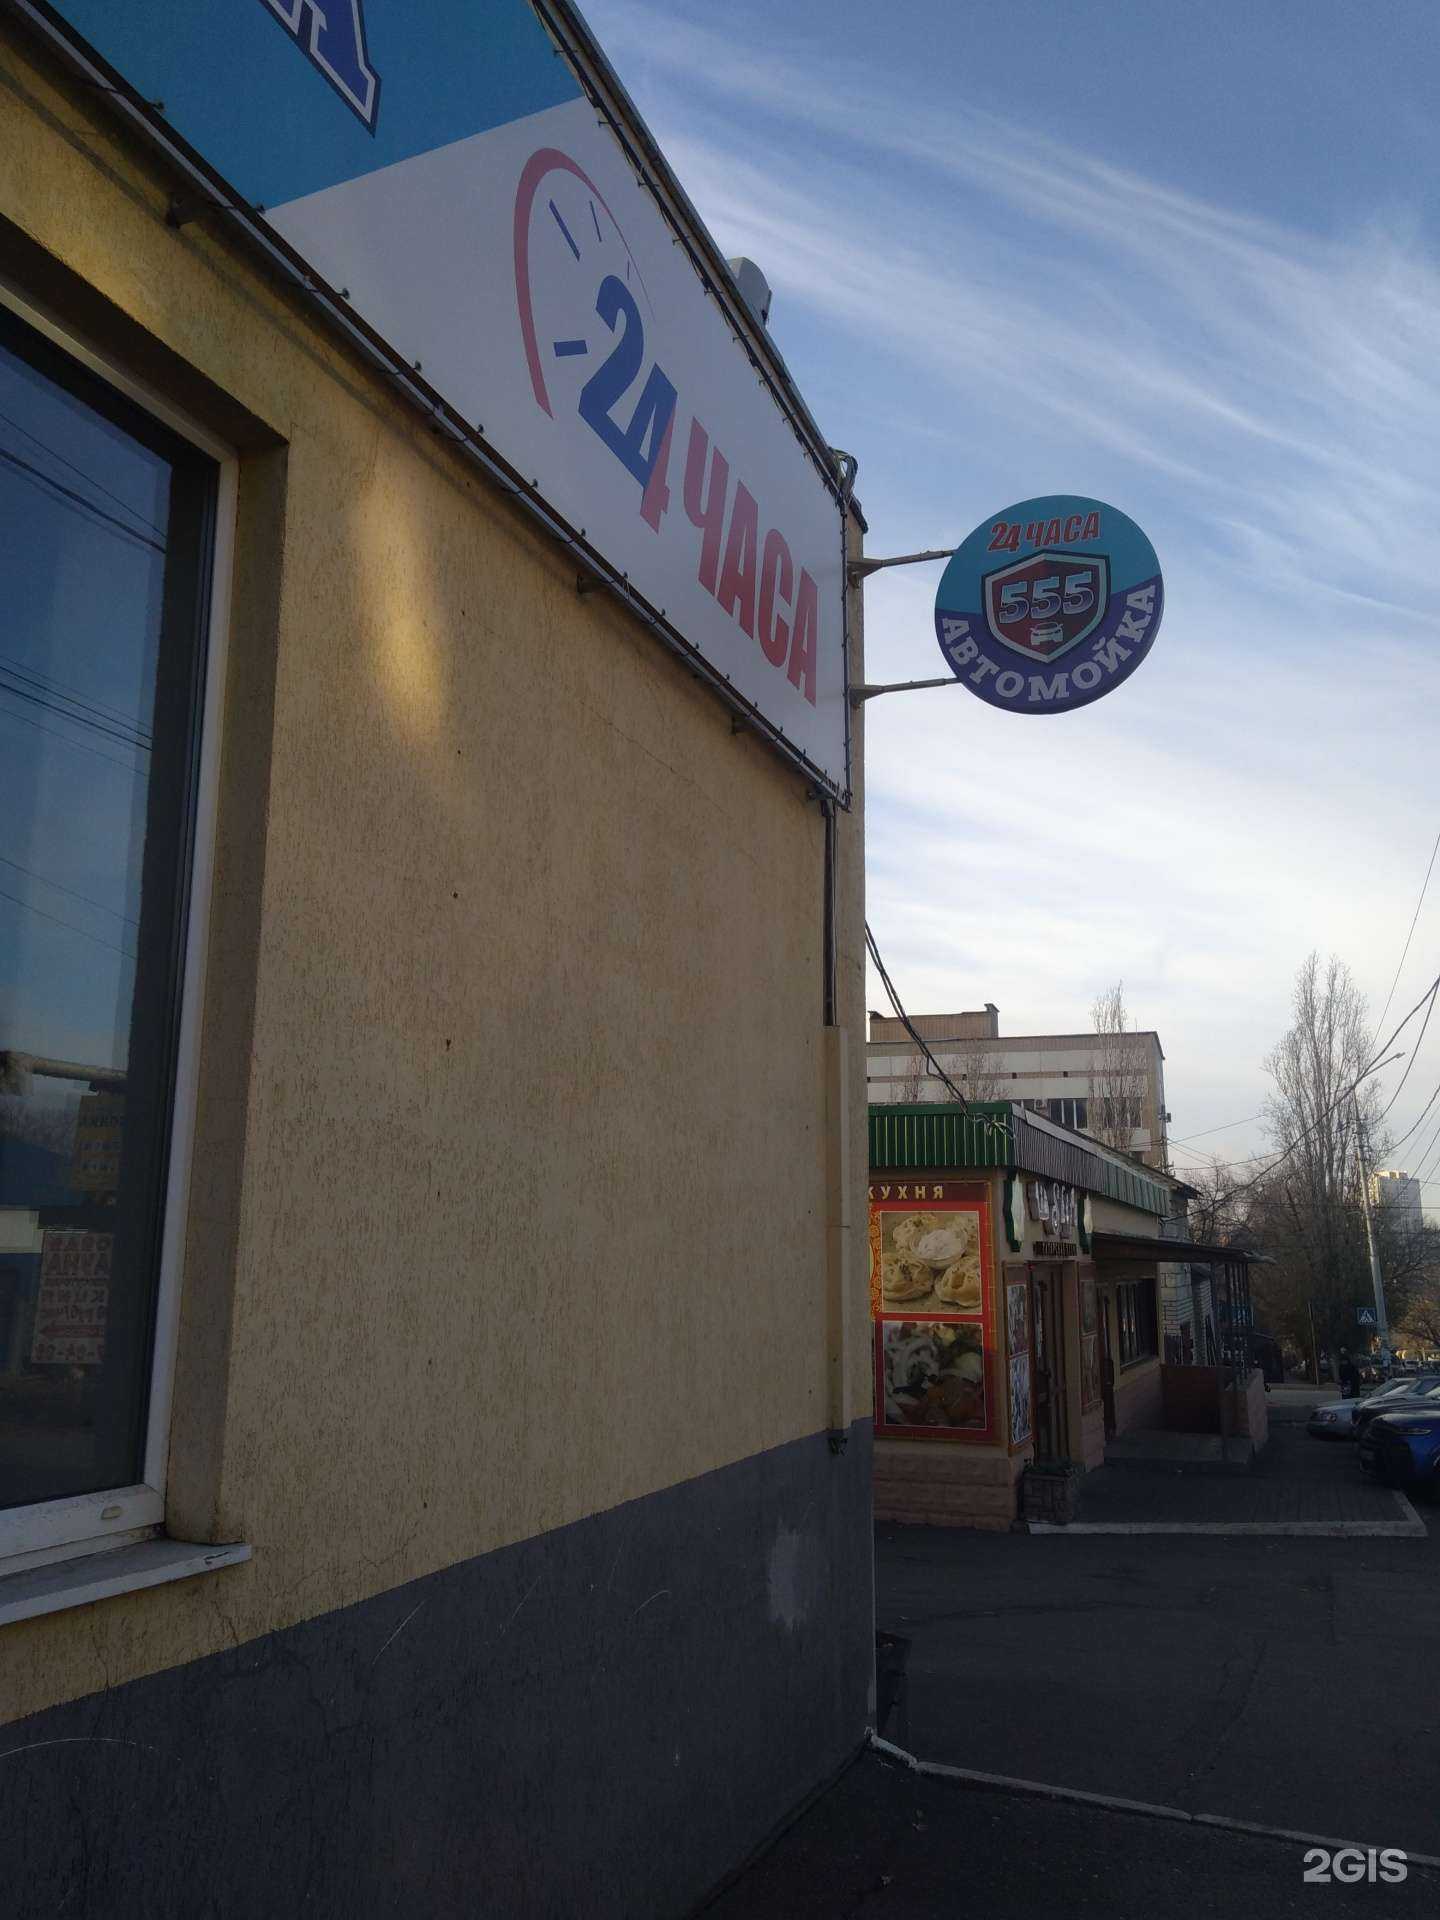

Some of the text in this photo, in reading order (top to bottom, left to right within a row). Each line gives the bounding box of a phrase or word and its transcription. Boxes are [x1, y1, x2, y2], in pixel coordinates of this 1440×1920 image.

[578, 275, 818, 708] 24 ЧАСА
[988, 511, 1100, 551] 24 ЧАСА
[999, 571, 1095, 624] 555
[942, 584, 1156, 701] АВТОМОЙКА
